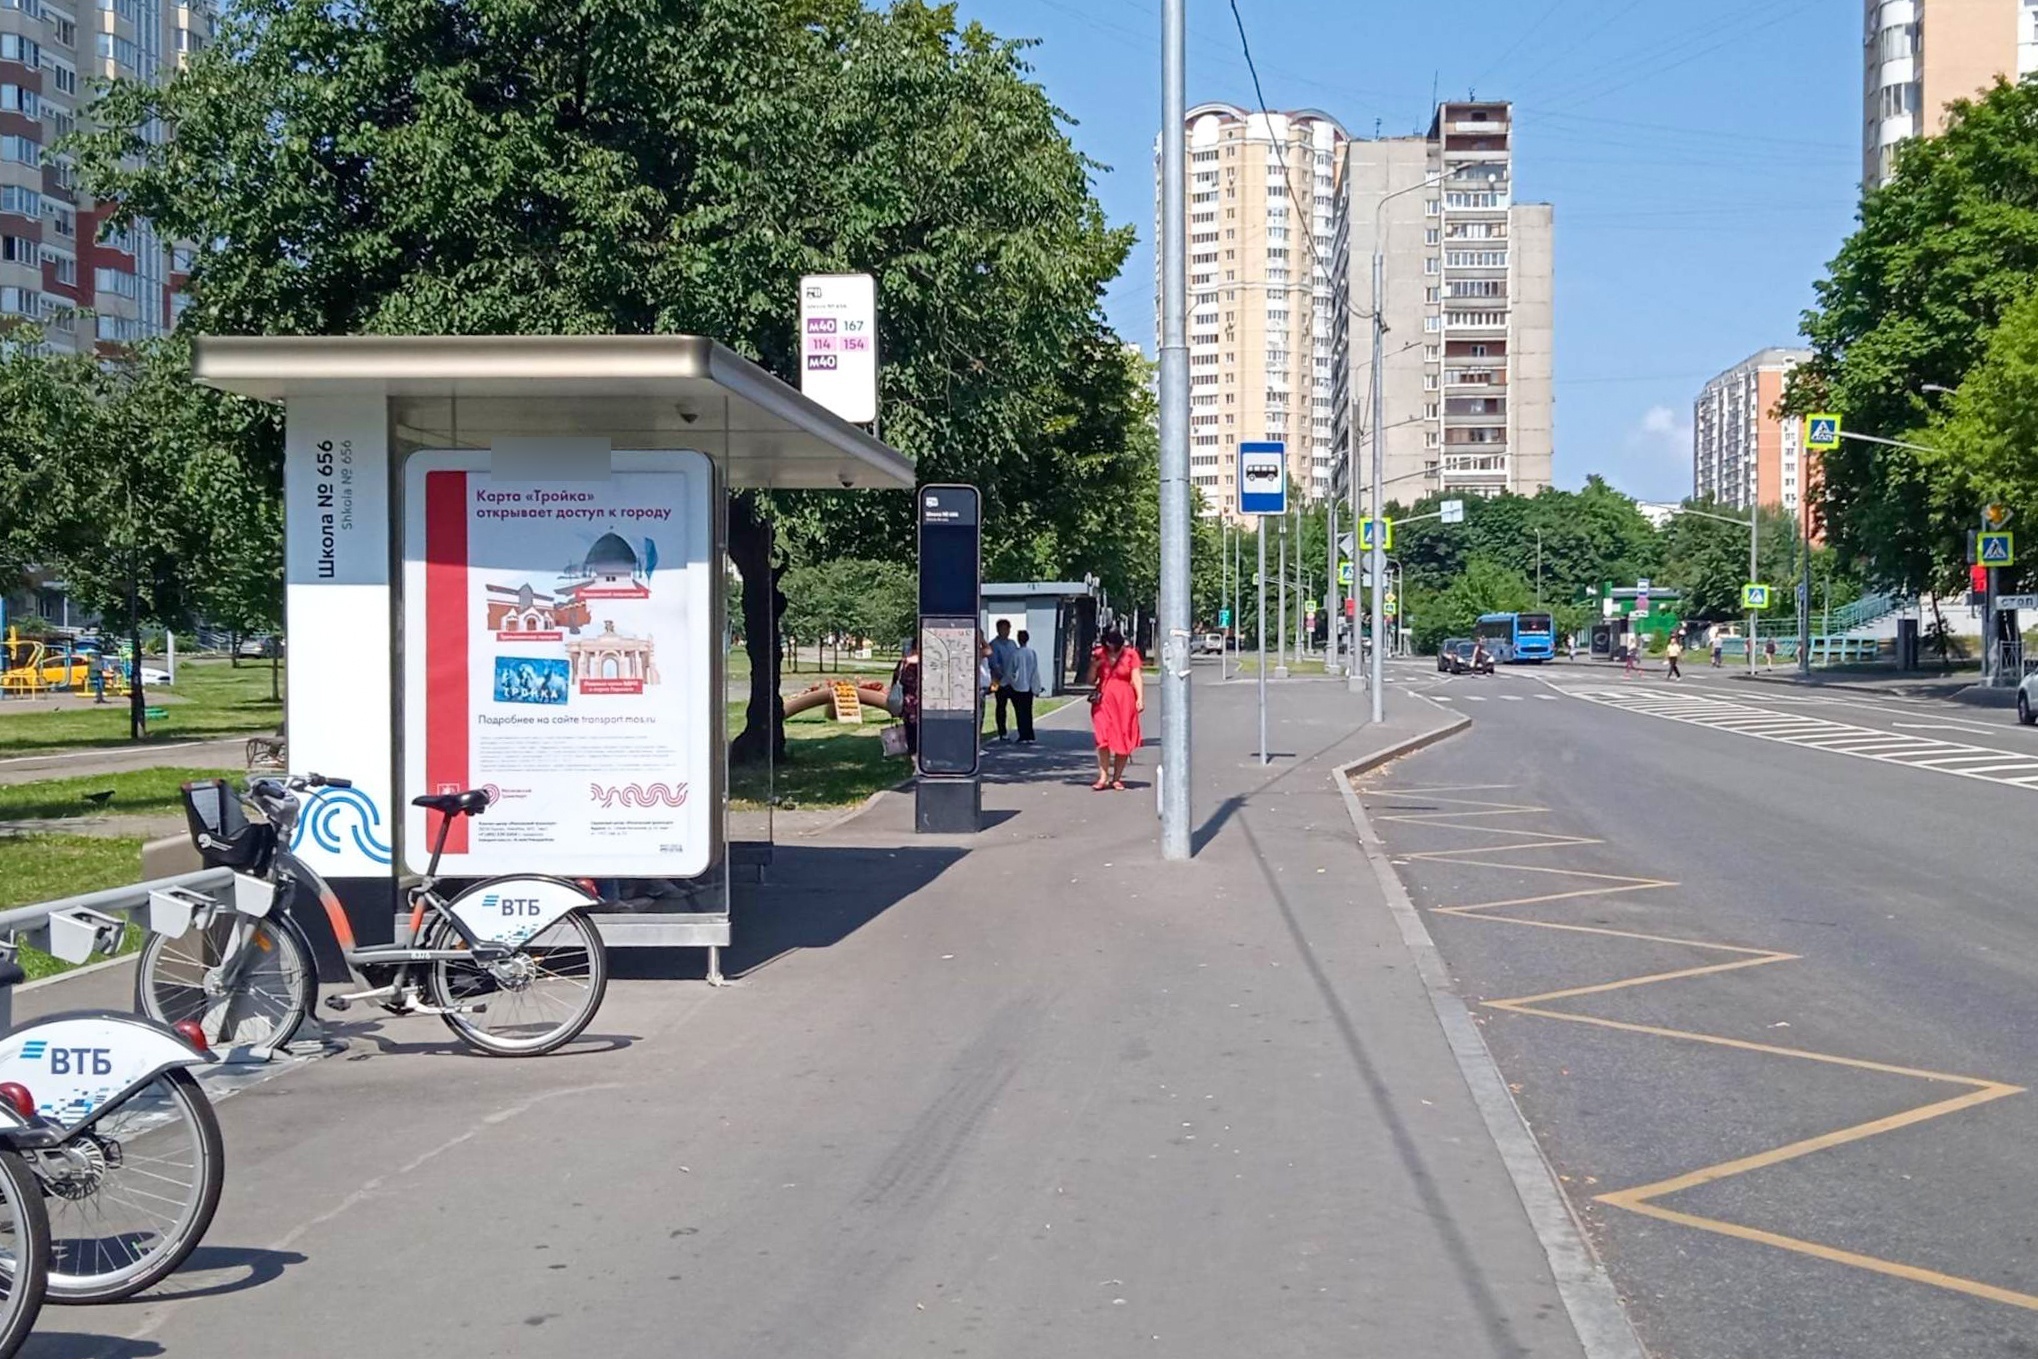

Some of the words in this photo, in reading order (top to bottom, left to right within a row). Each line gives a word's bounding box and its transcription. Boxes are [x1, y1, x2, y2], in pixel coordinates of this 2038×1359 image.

[844, 320, 864, 331] 167
[813, 339, 830, 350] 114
[843, 339, 864, 350] 154
[317, 440, 333, 477] 656
[341, 439, 352, 465] 656
[341, 468, 353, 485] №
[317, 483, 333, 507] №
[476, 489, 521, 505] Карта
[526, 489, 595, 505] «Тройка»
[341, 488, 353, 531] Shkola
[476, 508, 552, 521] открывает
[556, 508, 605, 521] доступ
[609, 508, 617, 518] к
[621, 507, 672, 521] городу
[318, 513, 334, 578] Школа
[478, 715, 535, 726] Подробнее
[552, 715, 580, 724] сайте
[581, 715, 656, 726] transport.mos.ru
[502, 899, 541, 916] ВТБ
[51, 1047, 112, 1075] ВТБ
